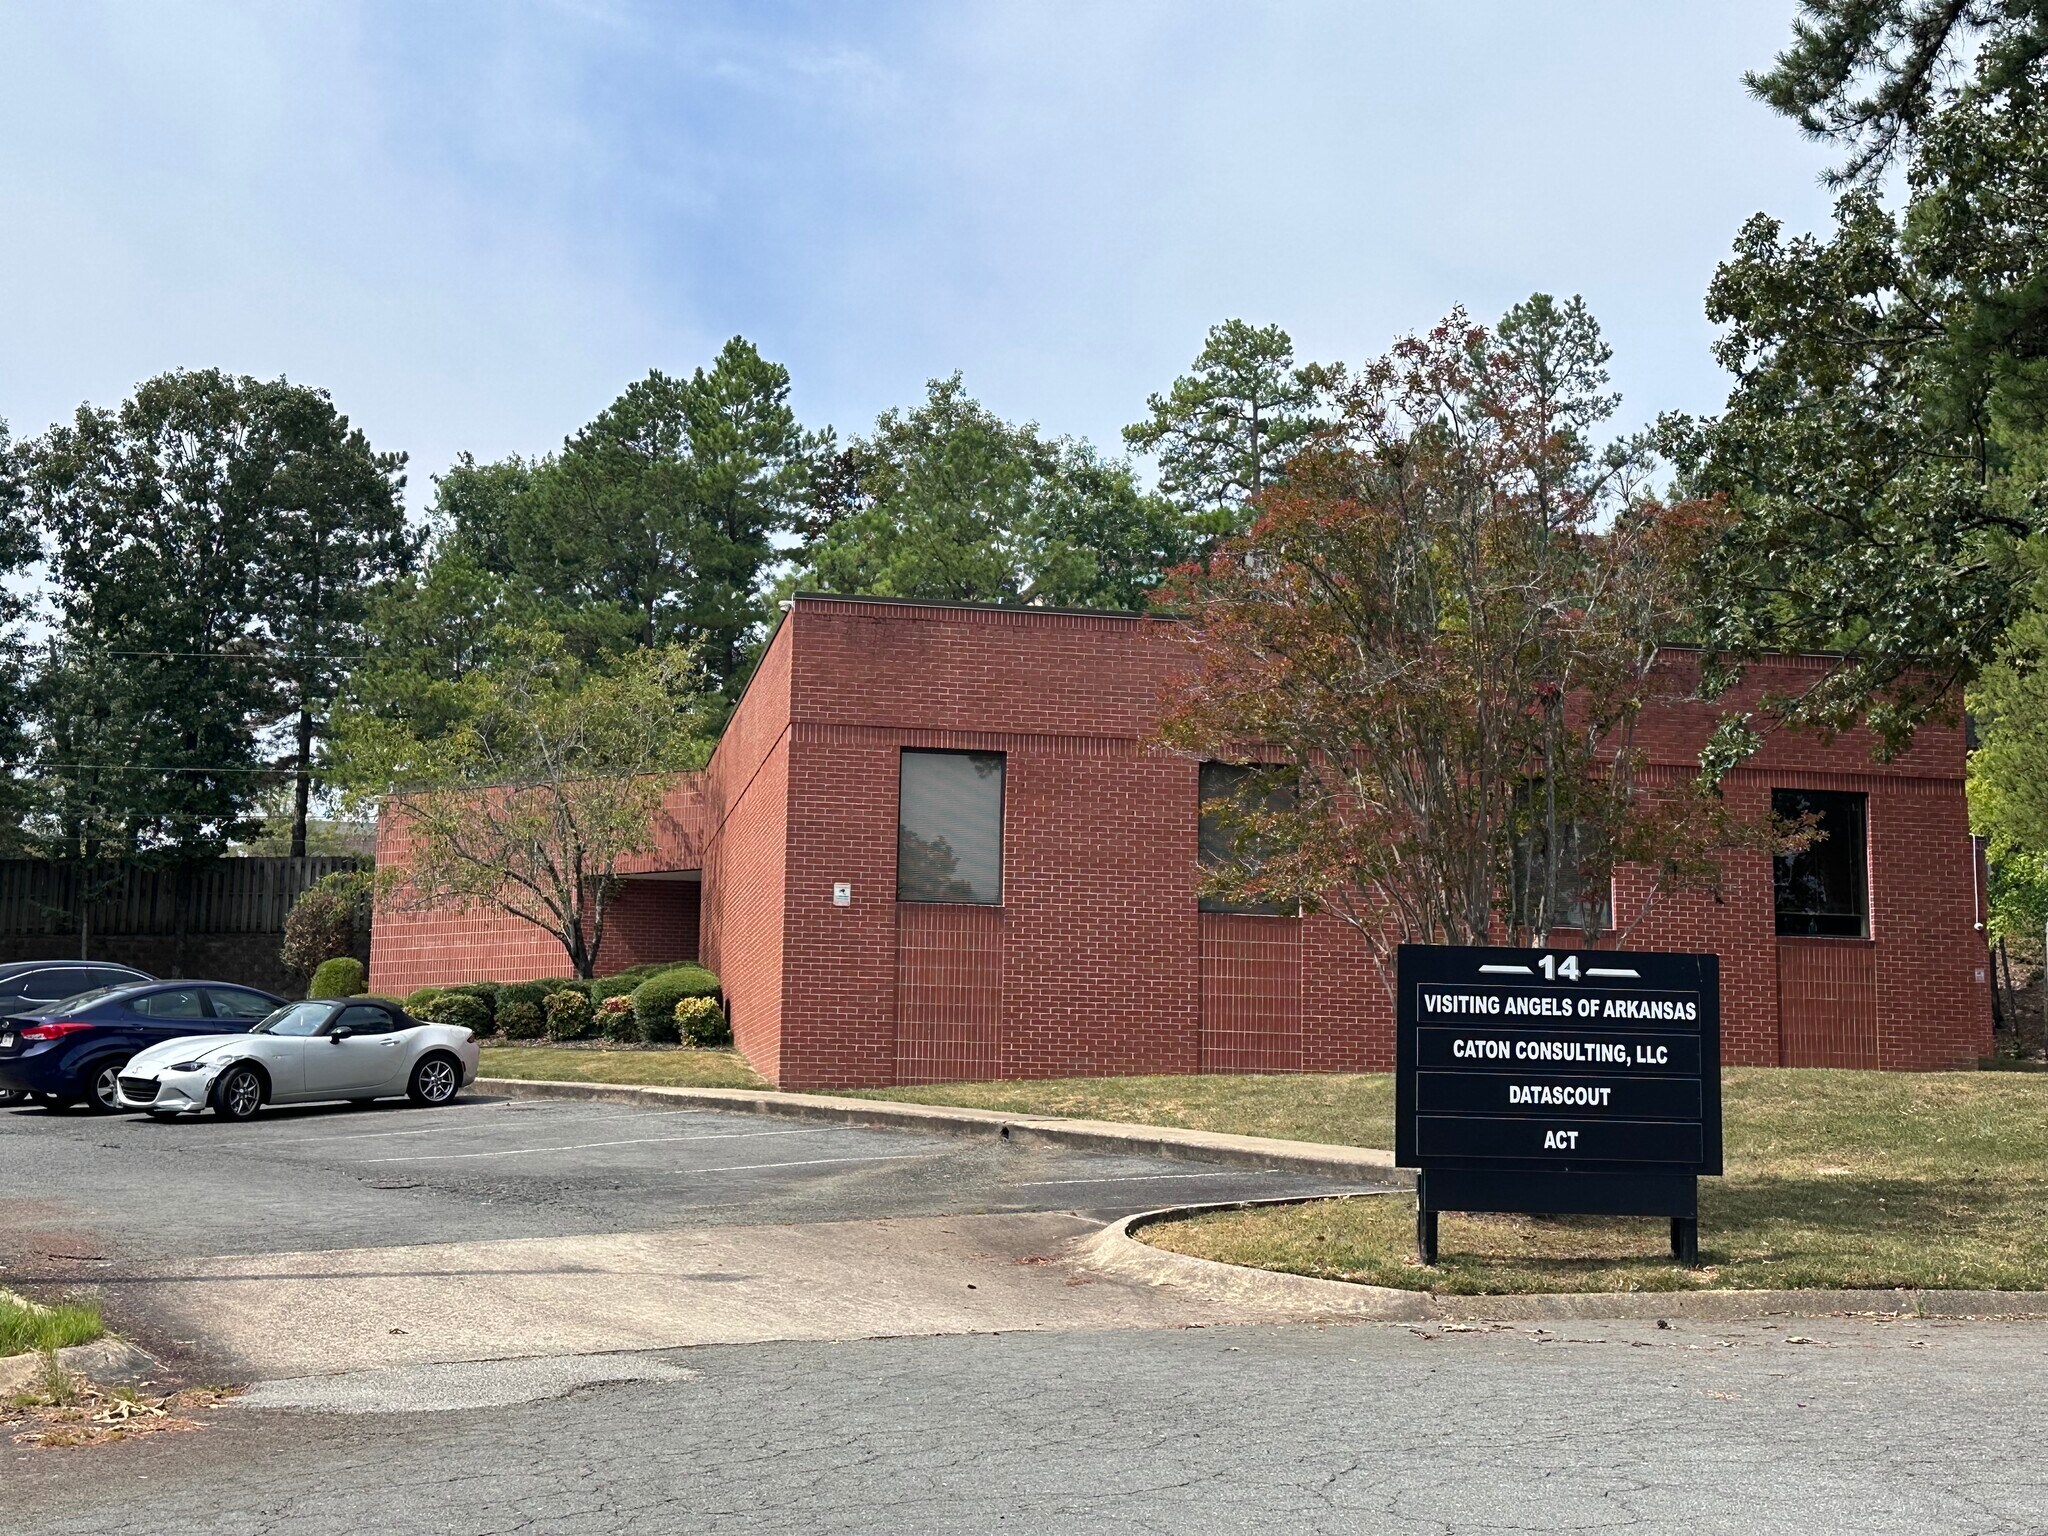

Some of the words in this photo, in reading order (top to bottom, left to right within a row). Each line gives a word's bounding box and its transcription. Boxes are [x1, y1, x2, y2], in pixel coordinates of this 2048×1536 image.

[1538, 954, 1581, 982] 14
[1424, 994, 1500, 1015] VISITING
[1504, 996, 1573, 1017] ANGELS
[1577, 998, 1601, 1018] OF
[1602, 999, 1697, 1021] ARKANSAS
[1453, 1039, 1511, 1059] CATON
[1515, 1041, 1632, 1067] CONSULTING,
[1636, 1045, 1668, 1065] LLC
[1509, 1085, 1611, 1106] DATASCOUT
[1543, 1130, 1579, 1150] ACT
